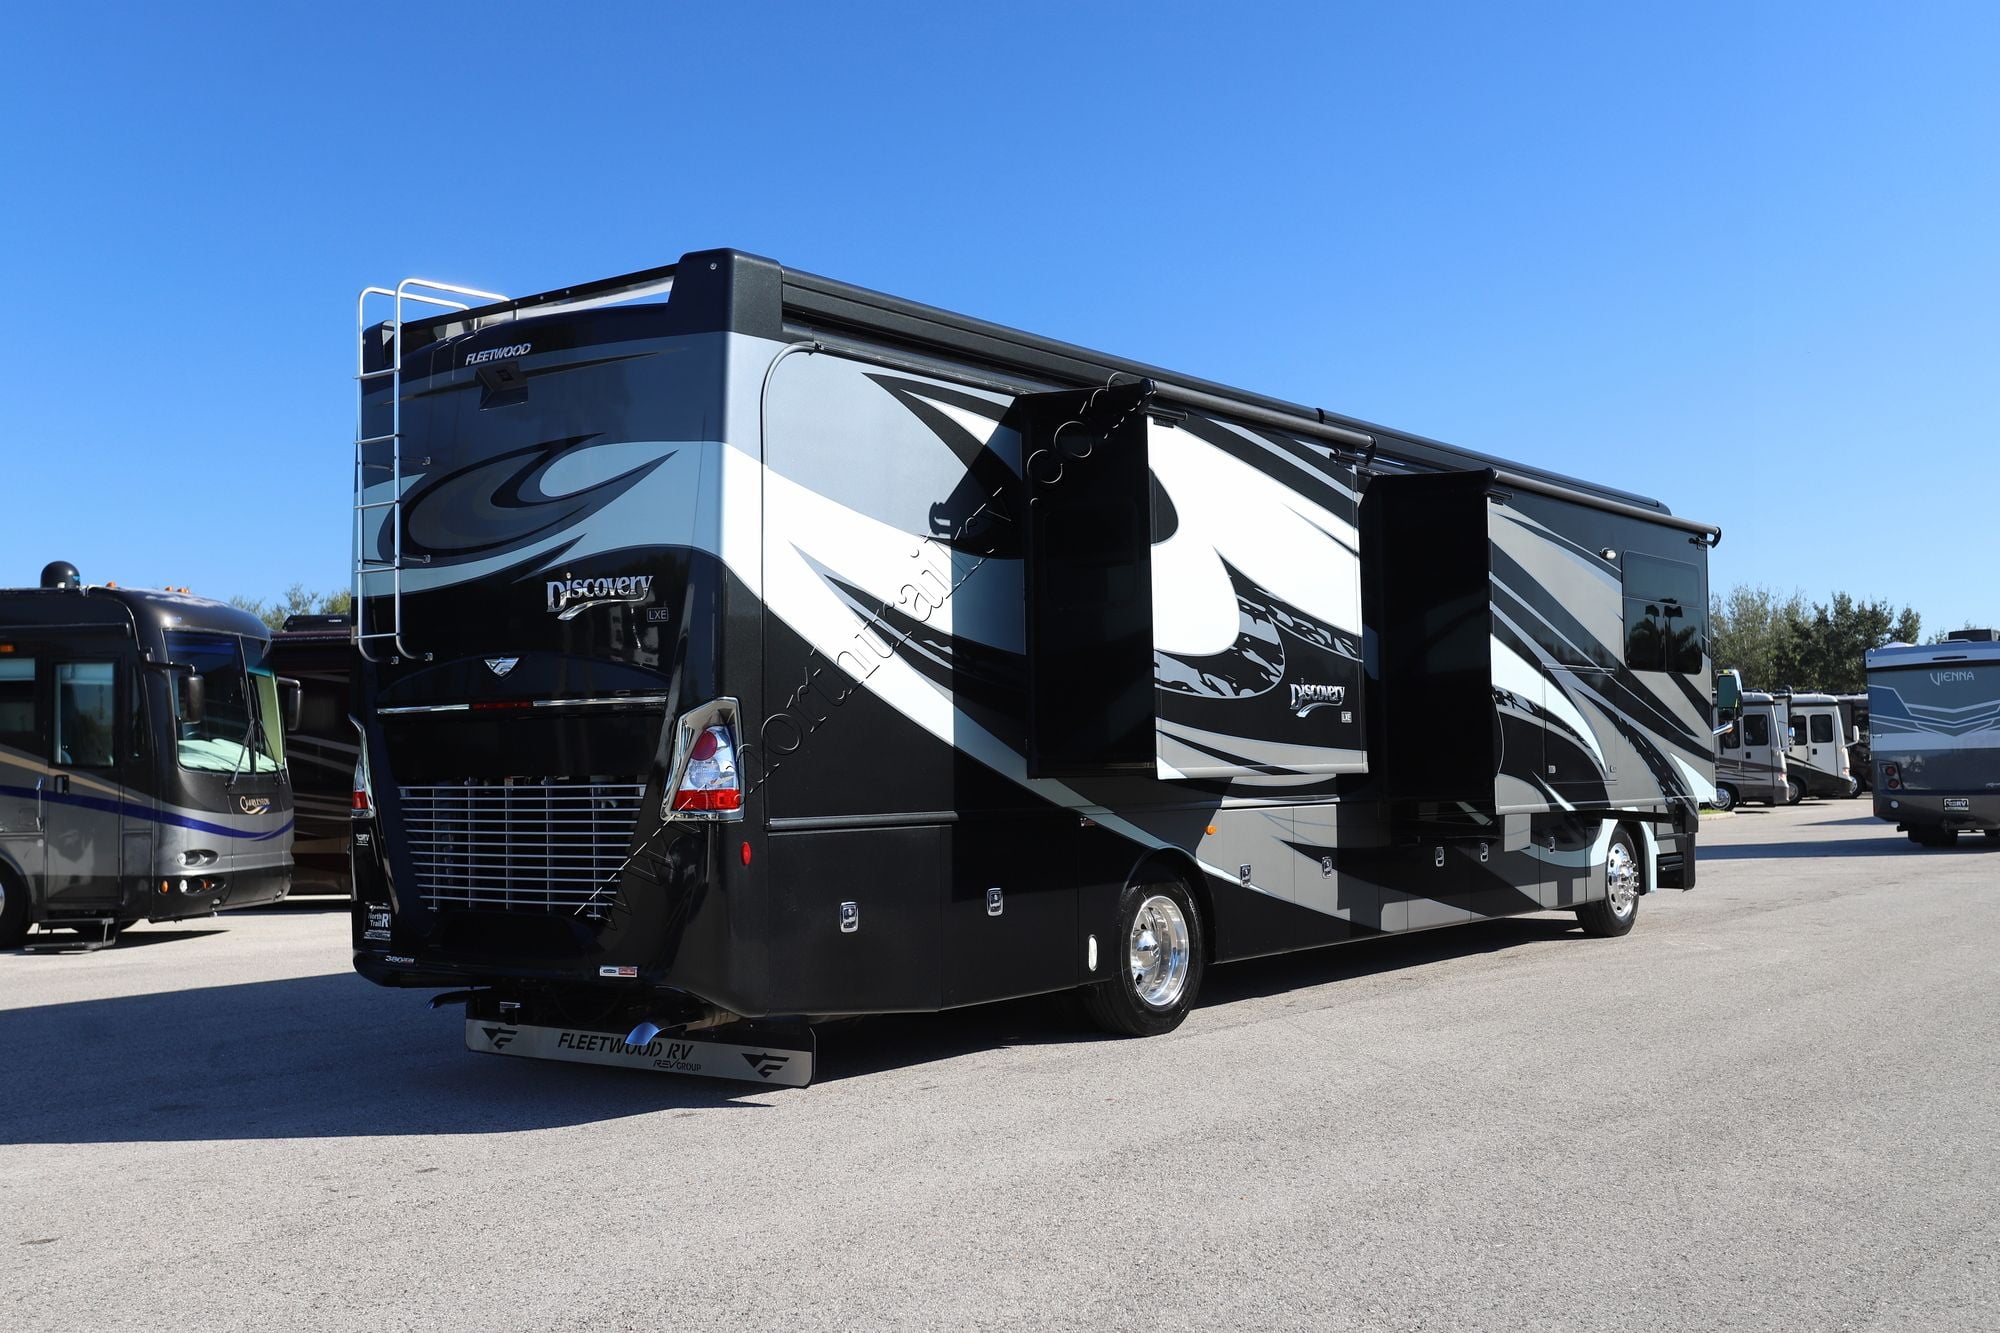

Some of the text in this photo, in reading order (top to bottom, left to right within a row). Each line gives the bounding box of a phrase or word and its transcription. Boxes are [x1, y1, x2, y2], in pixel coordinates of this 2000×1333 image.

[465, 343, 531, 365] FLEETWOOD
[546, 572, 653, 617] Discovery
[649, 610, 667, 620] LXE
[1930, 671, 1975, 686] VIENNA
[1289, 677, 1345, 714] Discovery
[558, 1032, 693, 1061] FLEETWOOD RV
